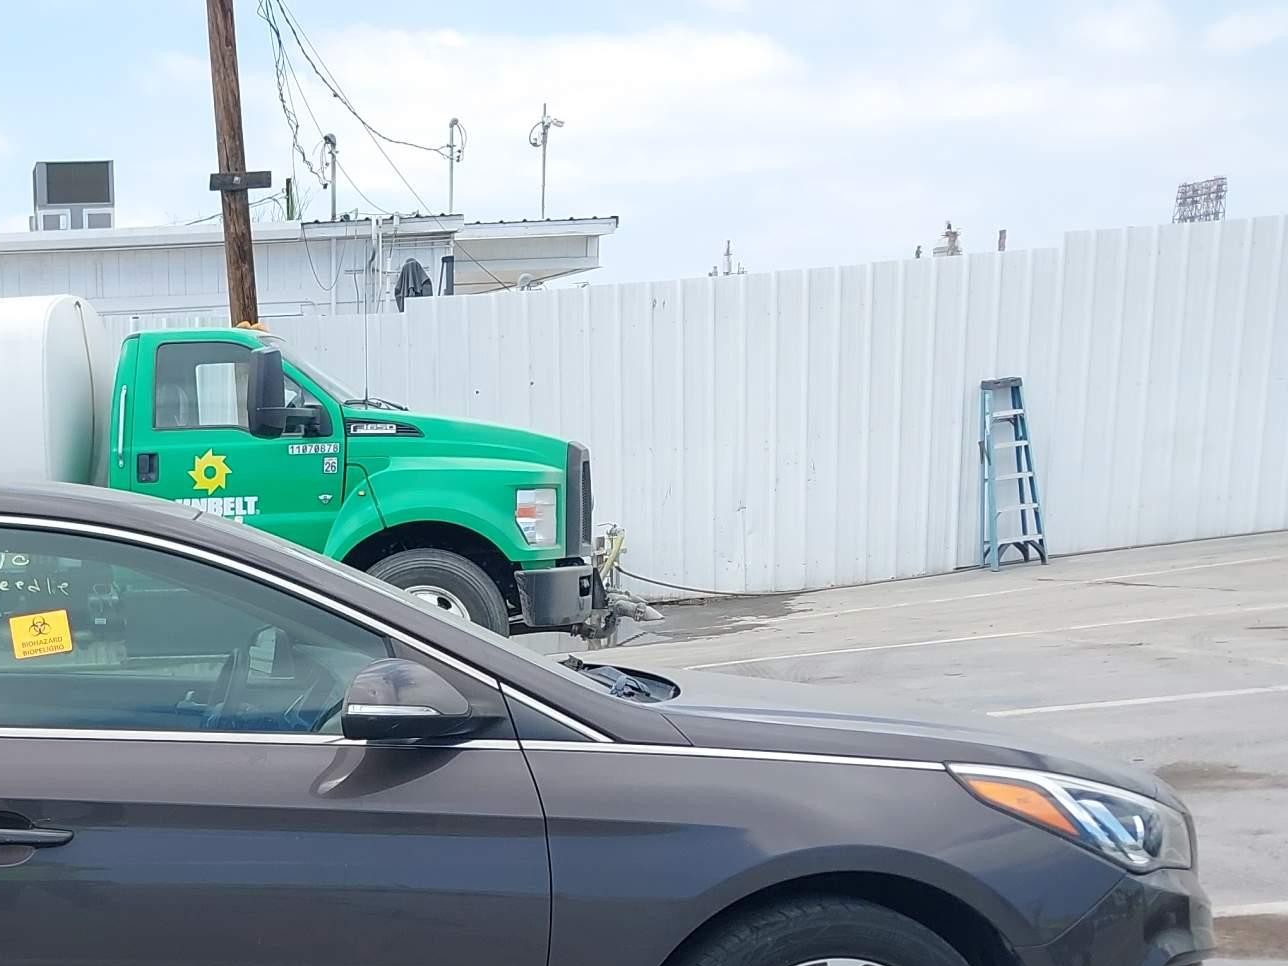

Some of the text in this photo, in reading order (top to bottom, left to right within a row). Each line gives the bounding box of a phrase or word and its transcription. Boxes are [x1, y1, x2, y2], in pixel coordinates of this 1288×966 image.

[289, 444, 339, 454] 11070878
[325, 461, 337, 473] 26
[175, 496, 259, 517] NBELT
[21, 636, 63, 649] BIOHAZARD
